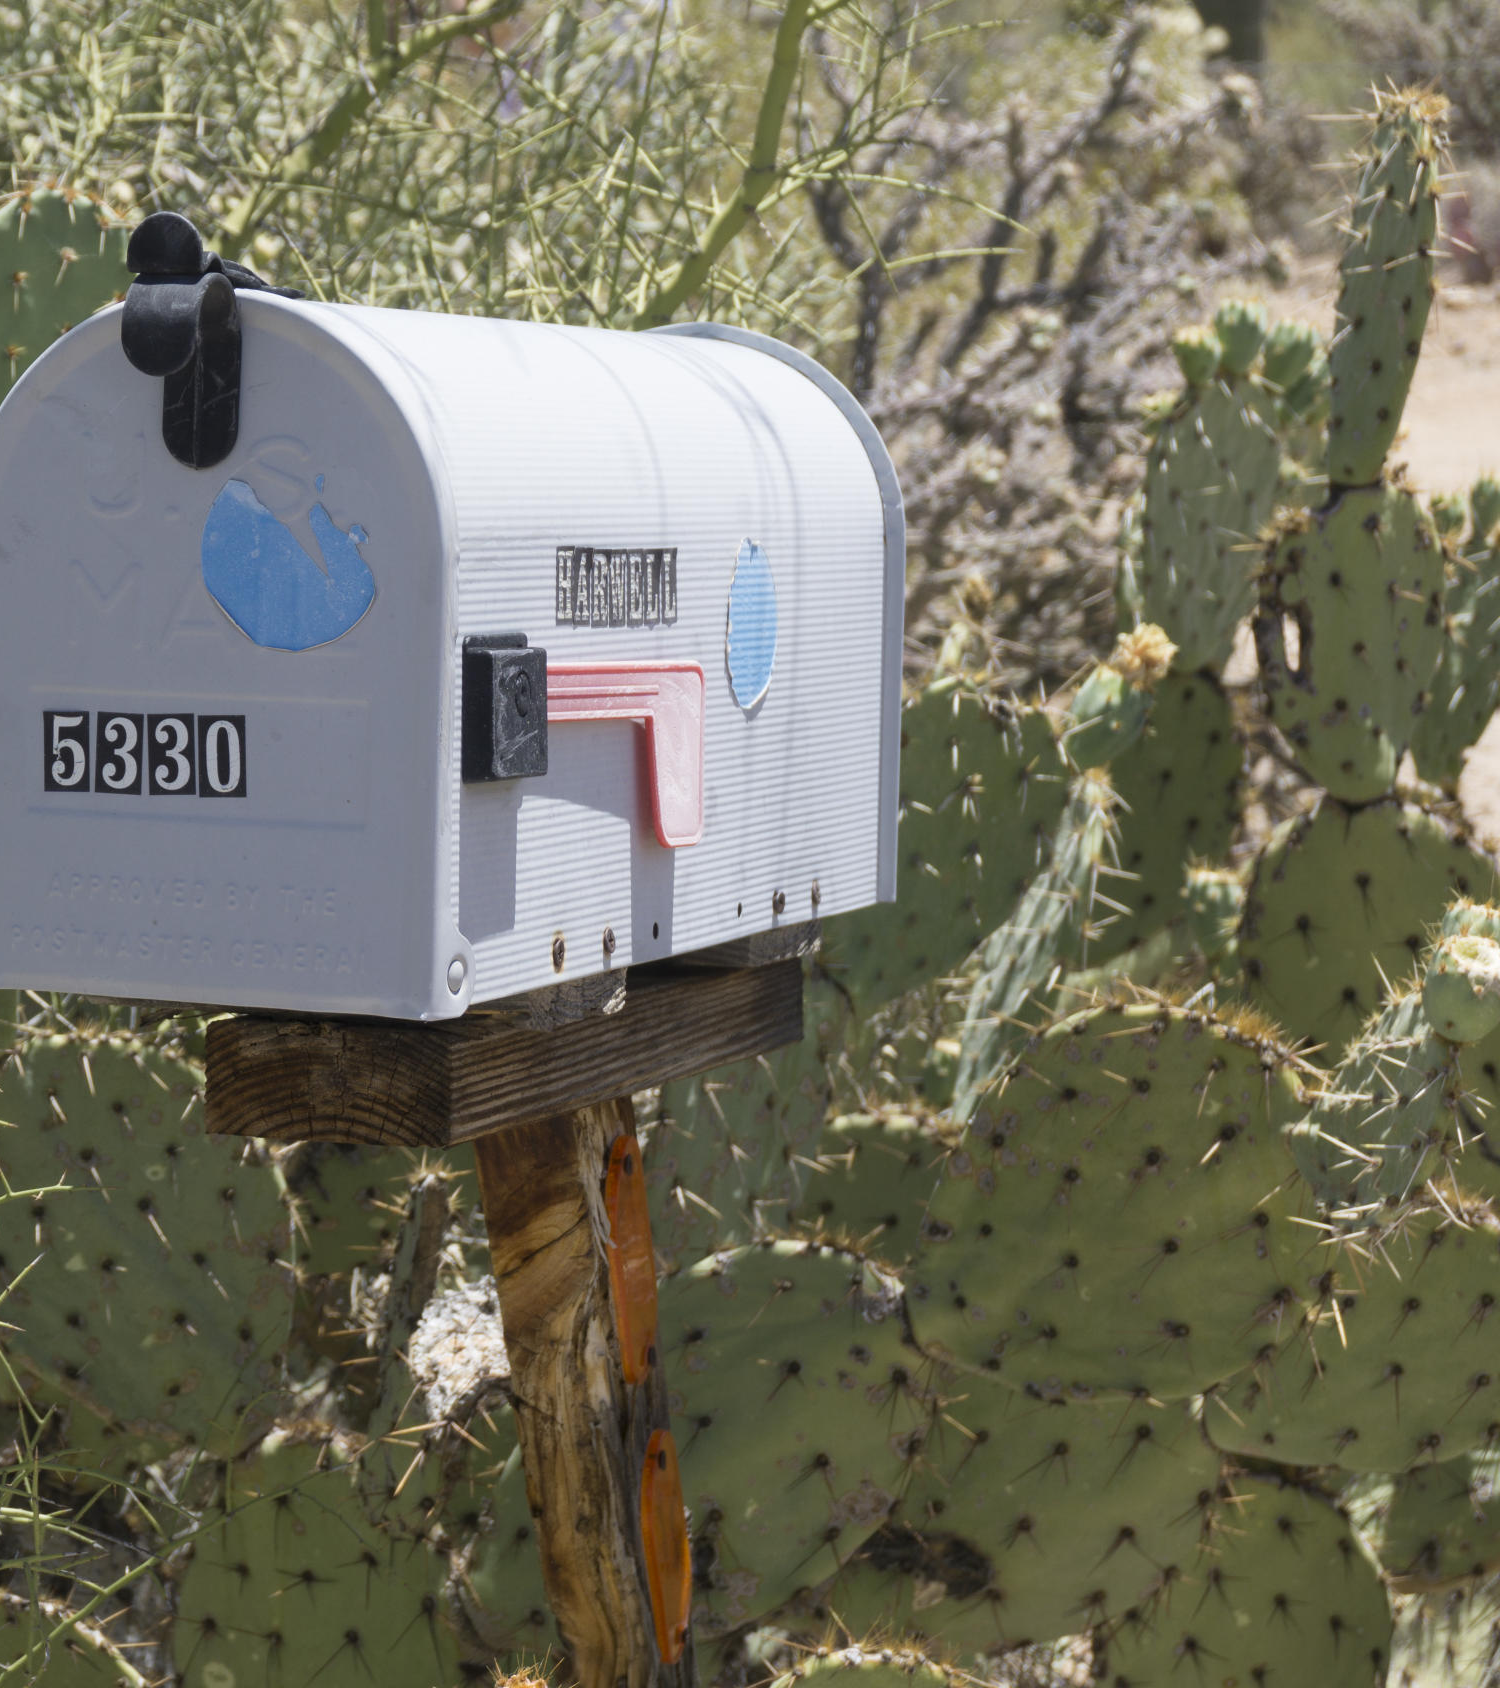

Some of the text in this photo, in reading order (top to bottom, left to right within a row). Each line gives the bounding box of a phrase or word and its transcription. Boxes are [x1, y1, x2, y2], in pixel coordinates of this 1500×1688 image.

[48, 713, 244, 795] 5330
[49, 872, 339, 918] APPROVED BY THE
[8, 924, 214, 967] POSTMASTER
